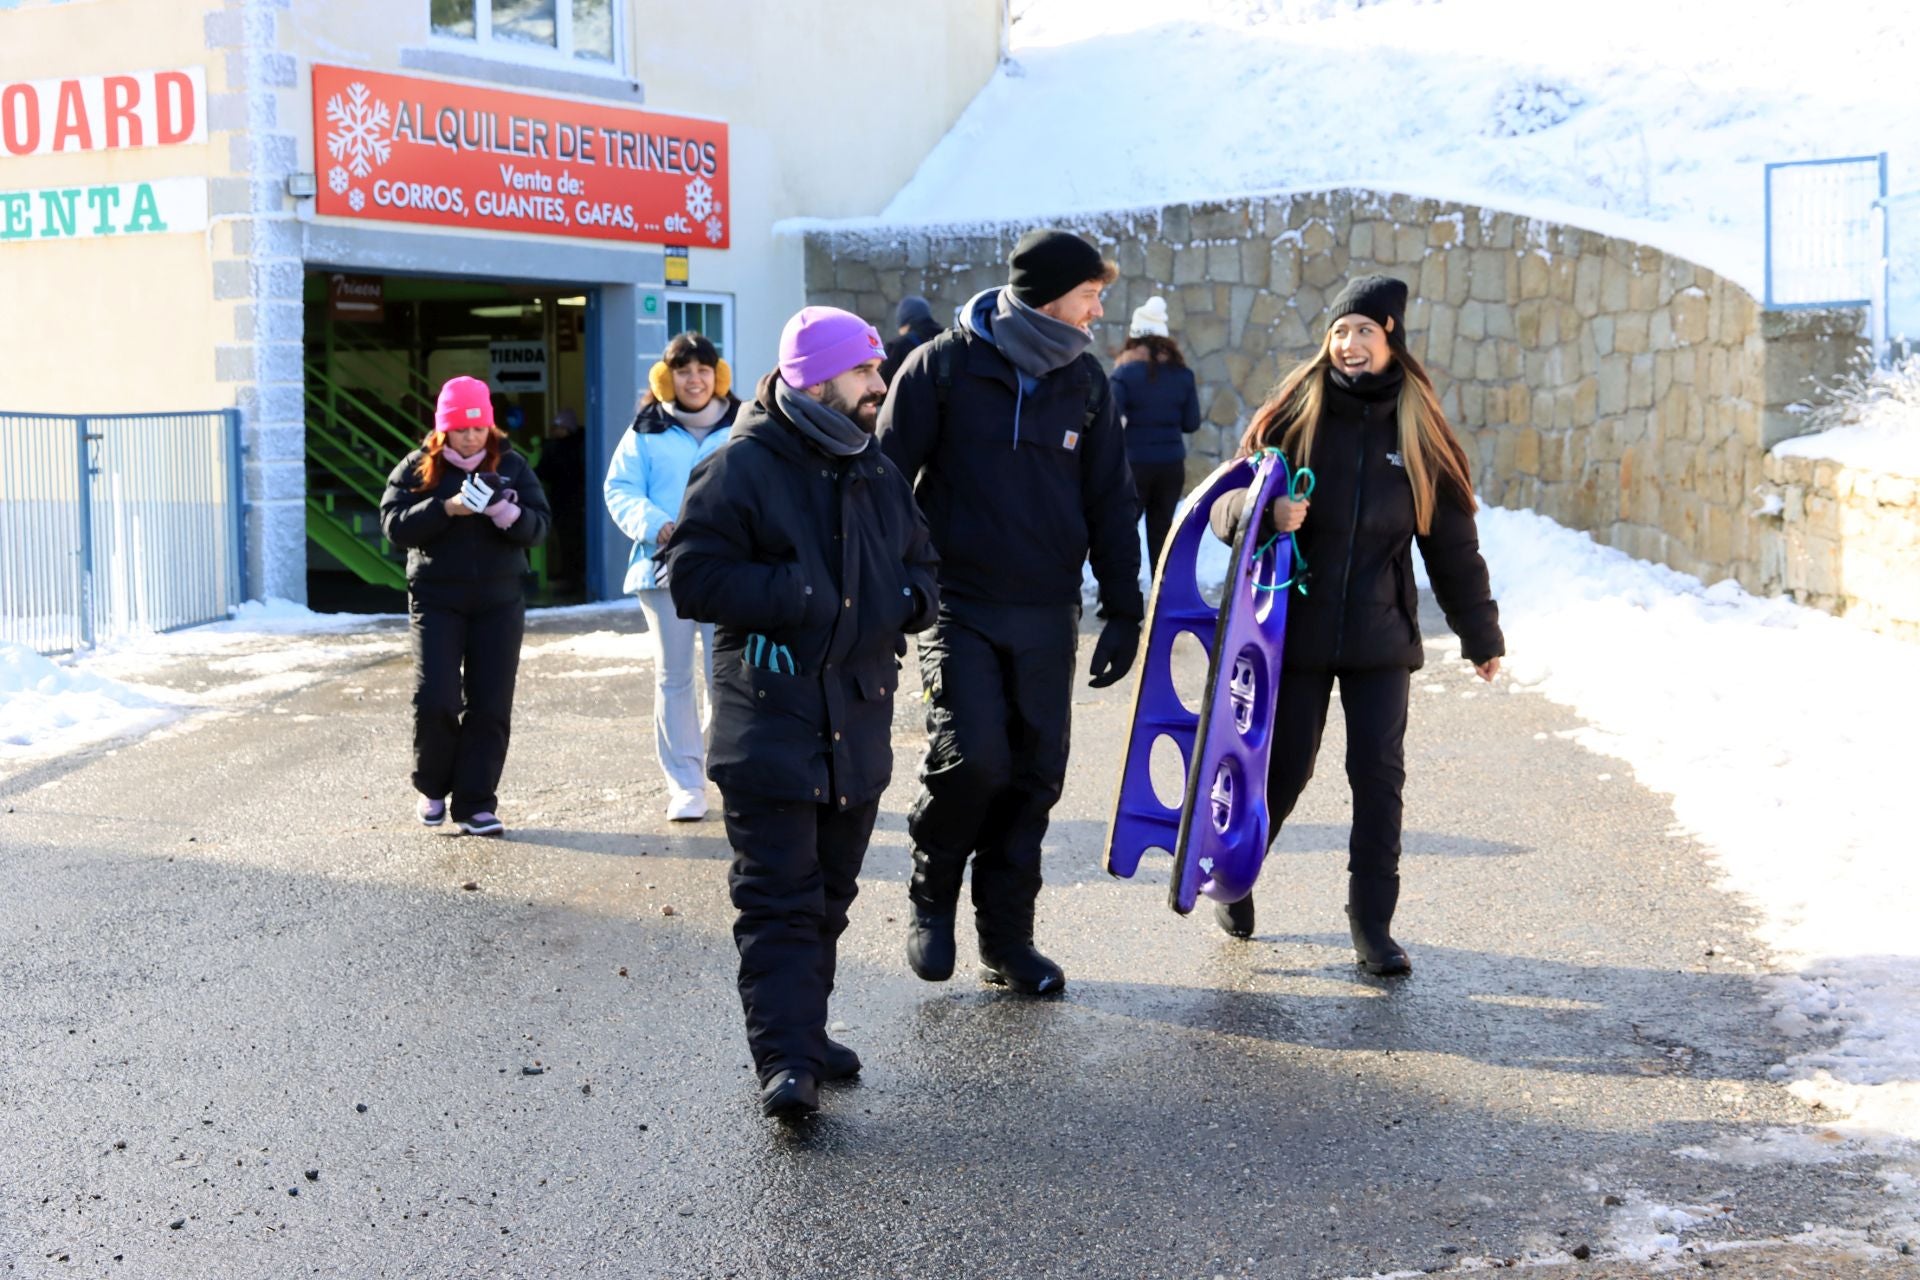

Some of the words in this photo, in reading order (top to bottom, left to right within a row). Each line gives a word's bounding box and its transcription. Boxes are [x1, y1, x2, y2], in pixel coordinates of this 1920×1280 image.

[2, 71, 195, 156] OARD
[391, 100, 549, 159] ALQUILER
[555, 122, 596, 166] DE
[599, 128, 717, 178] TRINEOS
[373, 179, 469, 217] GORROS,
[474, 190, 570, 226] GUANTES,
[575, 200, 639, 232] GAFAS,
[664, 212, 693, 234] etc.
[499, 163, 552, 193] Venta
[557, 169, 585, 195] de:
[0, 183, 168, 239] ENTA
[490, 347, 546, 364] TIENDA
